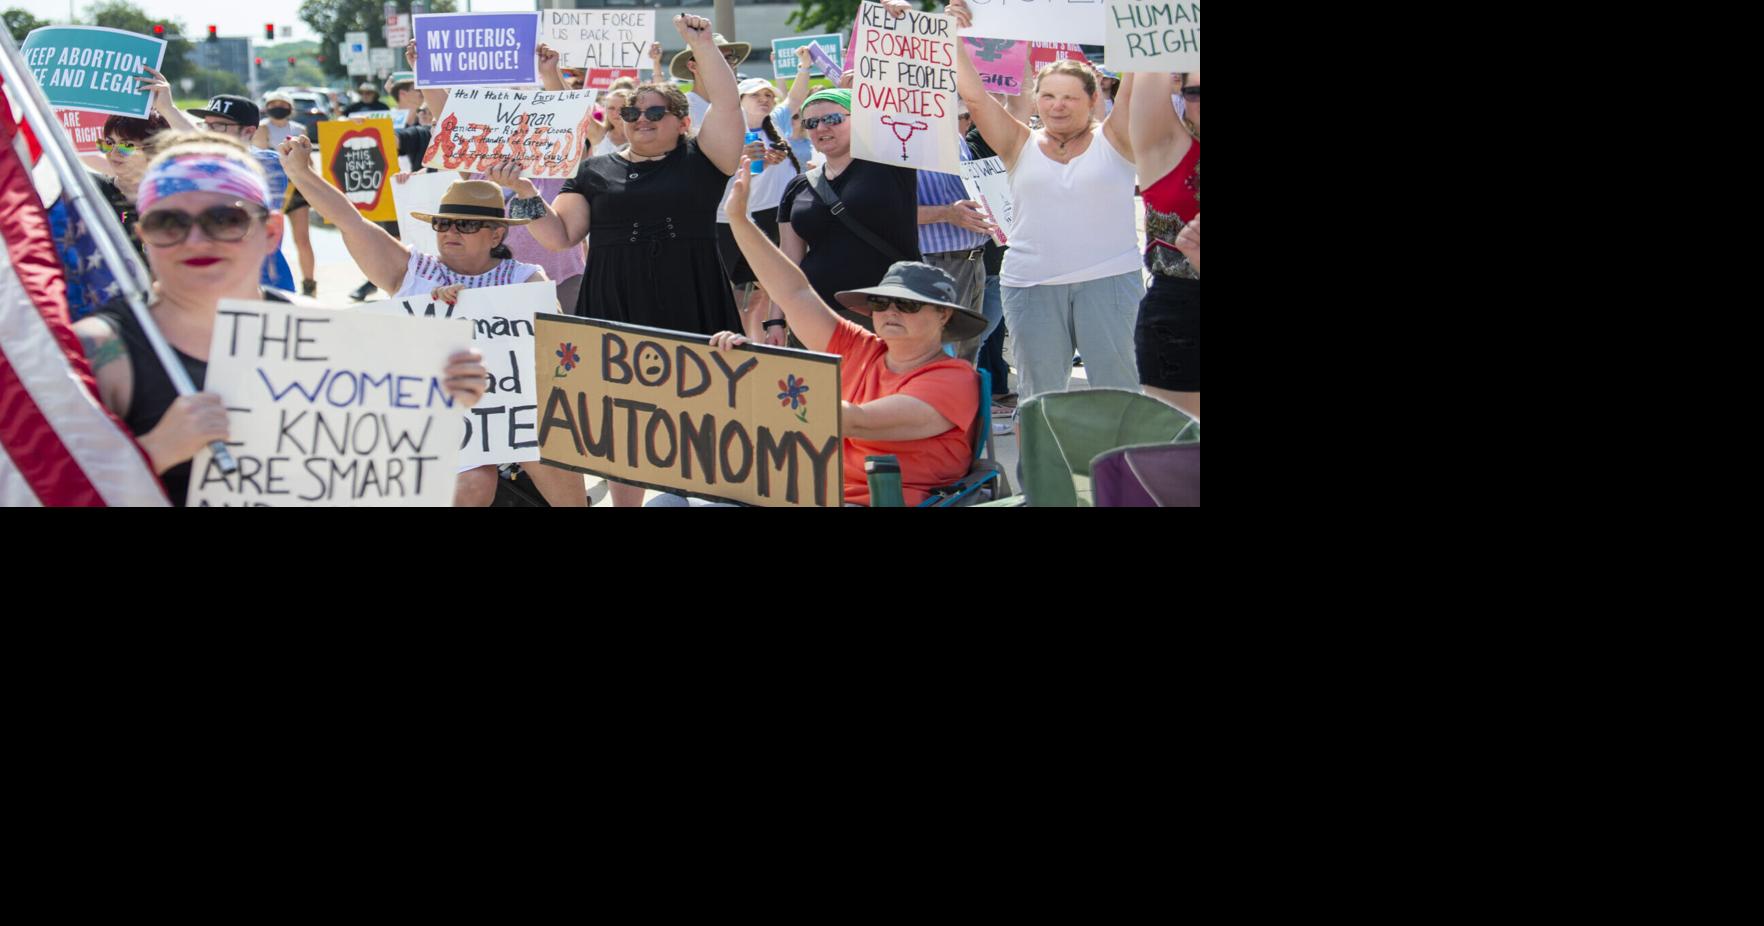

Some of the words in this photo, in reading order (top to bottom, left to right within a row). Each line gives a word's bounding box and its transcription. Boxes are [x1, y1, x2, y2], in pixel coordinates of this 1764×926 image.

[602, 13, 645, 26] FORCE
[862, 3, 906, 30] KEEP
[909, 12, 949, 37] YOUR
[427, 30, 450, 49] MY
[455, 28, 521, 49] UTERUS,
[552, 28, 568, 40] US
[580, 28, 610, 40] BACK
[618, 29, 633, 40] TO
[866, 29, 954, 67] ROSARIES
[1126, 28, 1200, 58] RIGH
[57, 47, 147, 74] ABORTION
[430, 52, 452, 72] MY
[458, 50, 519, 71] CHOICE!
[584, 40, 646, 68] ALLEY
[860, 56, 889, 80] OFF
[49, 68, 85, 88] AND
[90, 70, 143, 96] LEGAL
[454, 89, 479, 100] Hell
[484, 90, 509, 100] Hath
[513, 92, 528, 101] No
[496, 102, 555, 127] Woman
[858, 83, 946, 118] OVARIES
[63, 111, 80, 127] ARE
[75, 126, 104, 143] RIGHT
[345, 170, 382, 191] 1950
[218, 310, 331, 361] THE
[602, 332, 758, 408] BODY
[257, 368, 454, 409] WOMEN
[276, 409, 433, 456] KNOW
[538, 386, 839, 507] AUTONOMY
[198, 456, 290, 495] ARE
[299, 456, 438, 501] SMART
